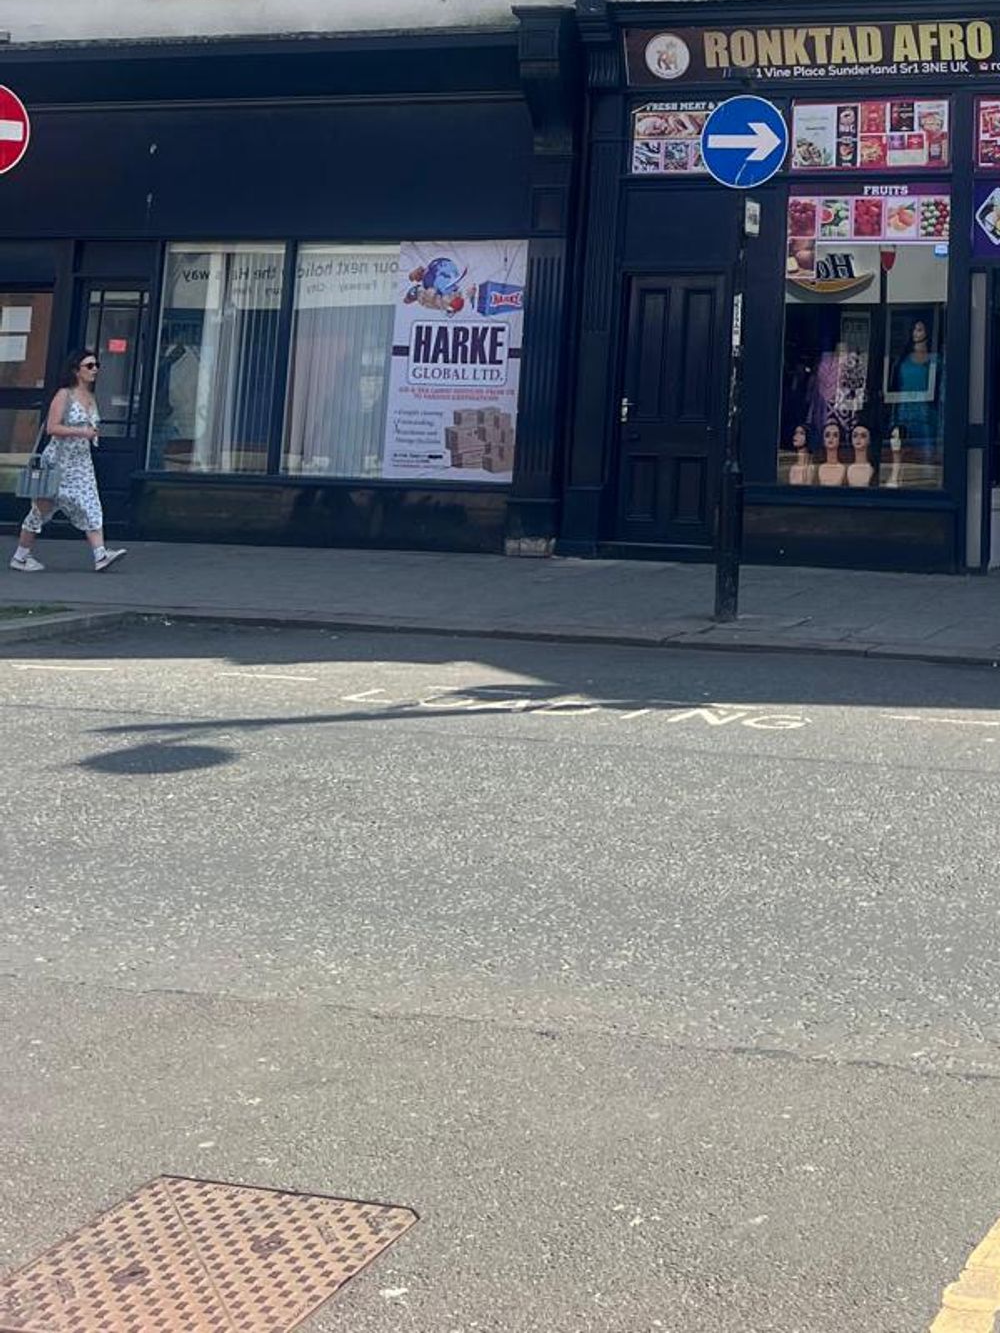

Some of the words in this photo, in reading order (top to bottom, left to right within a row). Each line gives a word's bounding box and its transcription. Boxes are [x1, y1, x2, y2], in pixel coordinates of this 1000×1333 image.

[703, 25, 884, 68] RONKTAD
[893, 20, 993, 63] AFRO
[765, 66, 791, 78] Vine
[793, 65, 826, 77] Place
[828, 64, 897, 76] Sunderland
[900, 63, 920, 74] Sr1
[922, 62, 948, 74] 3NE
[950, 61, 969, 72] UK
[646, 102, 678, 111] FRESH
[680, 101, 706, 110] MEAT
[863, 185, 909, 196] FRUITS
[413, 325, 506, 365] HARKE
[412, 367, 470, 381] GLOBAL
[473, 368, 504, 382] LTD.
